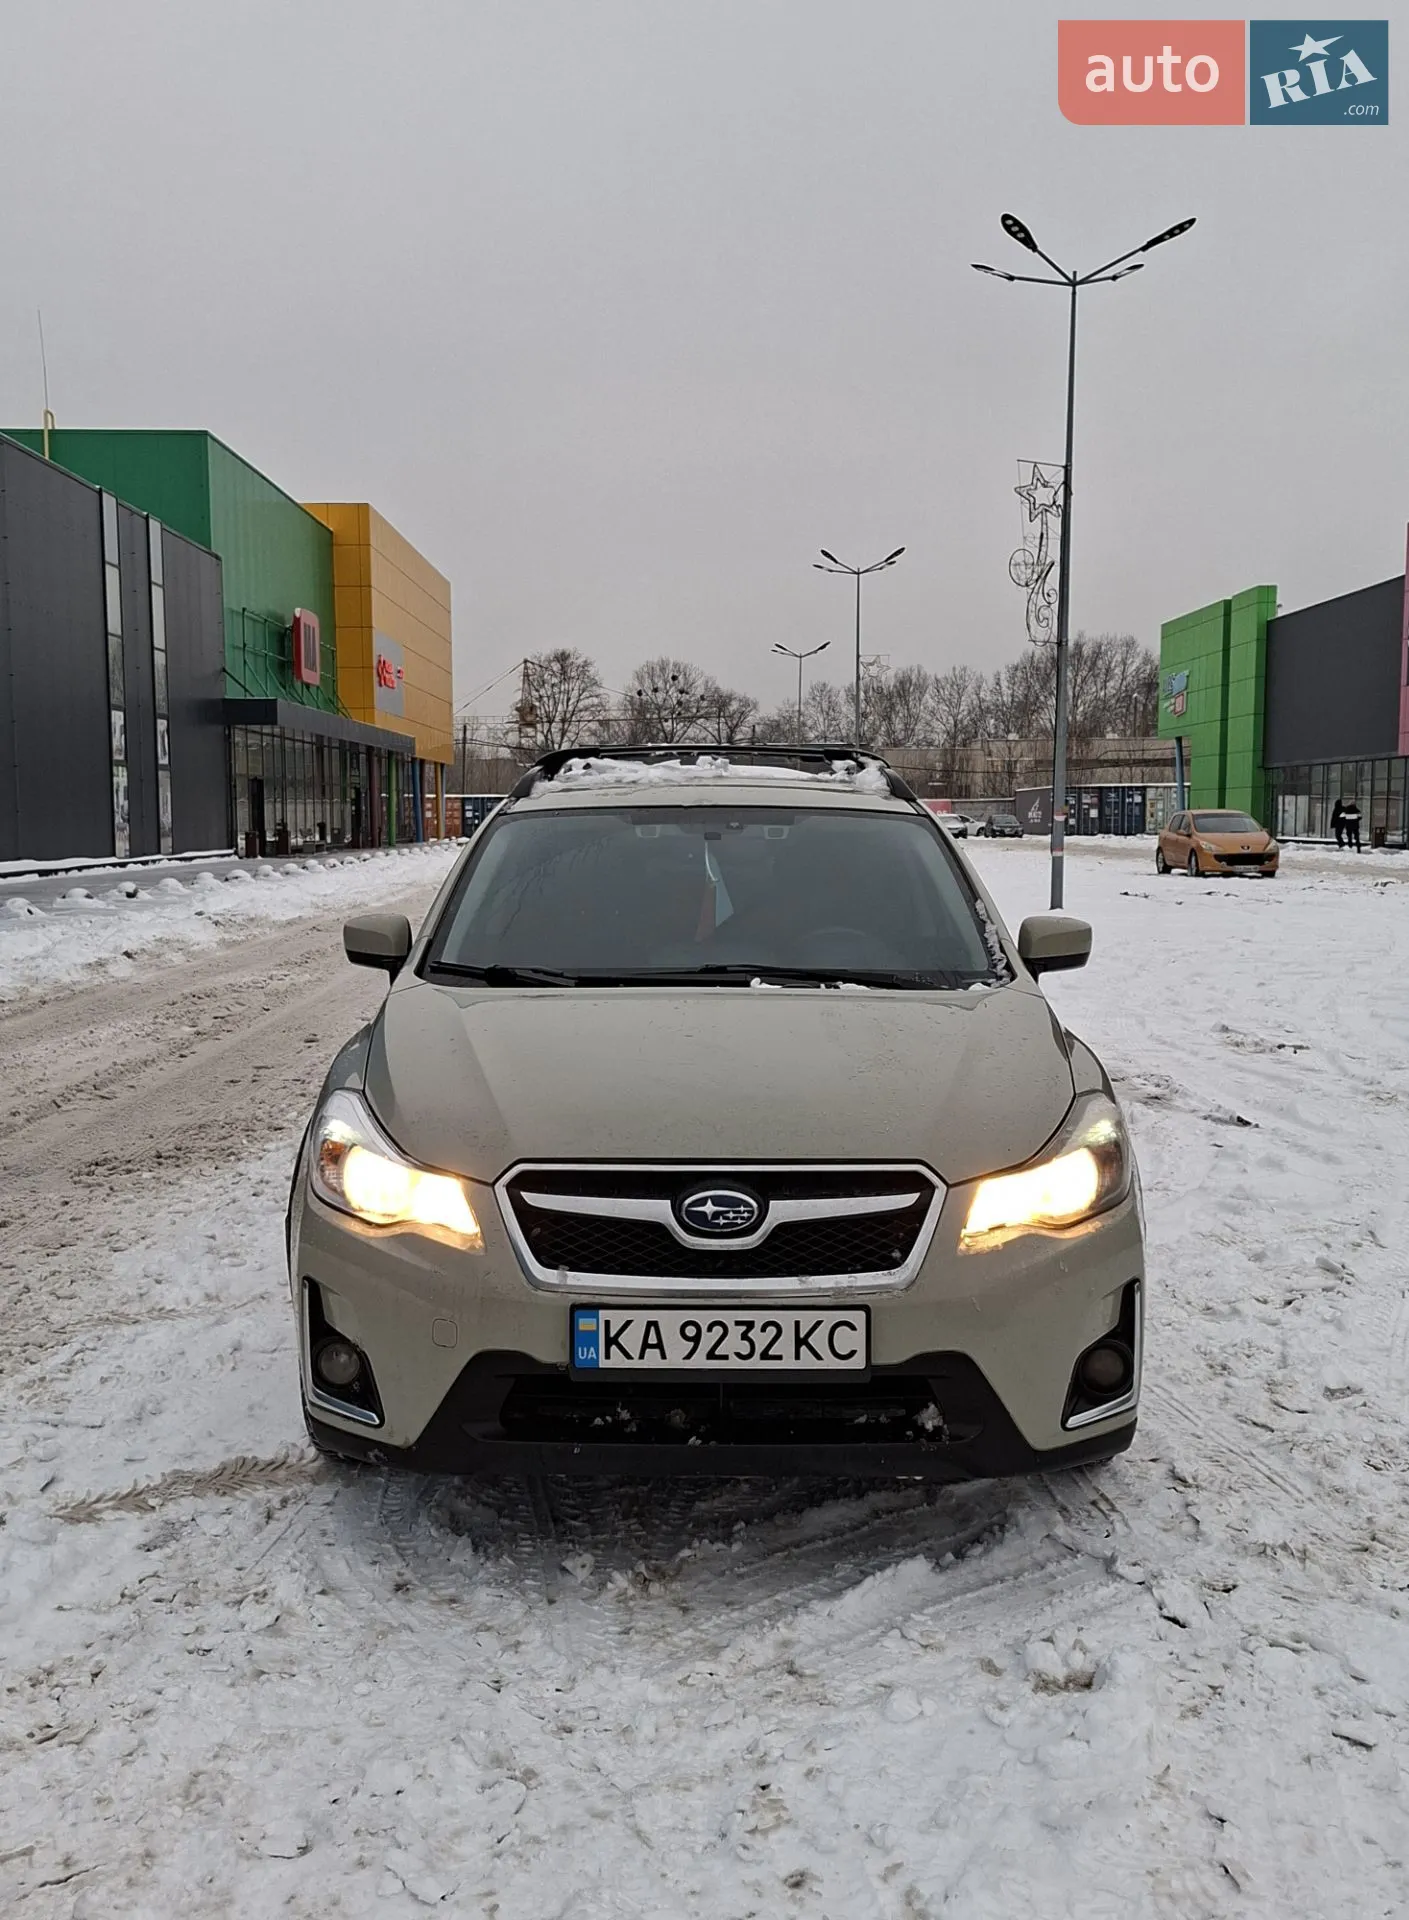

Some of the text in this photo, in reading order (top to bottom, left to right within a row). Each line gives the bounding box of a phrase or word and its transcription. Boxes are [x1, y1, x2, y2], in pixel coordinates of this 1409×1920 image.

[578, 1346, 597, 1360] UA
[604, 1319, 858, 1361] KA 9232 KC
